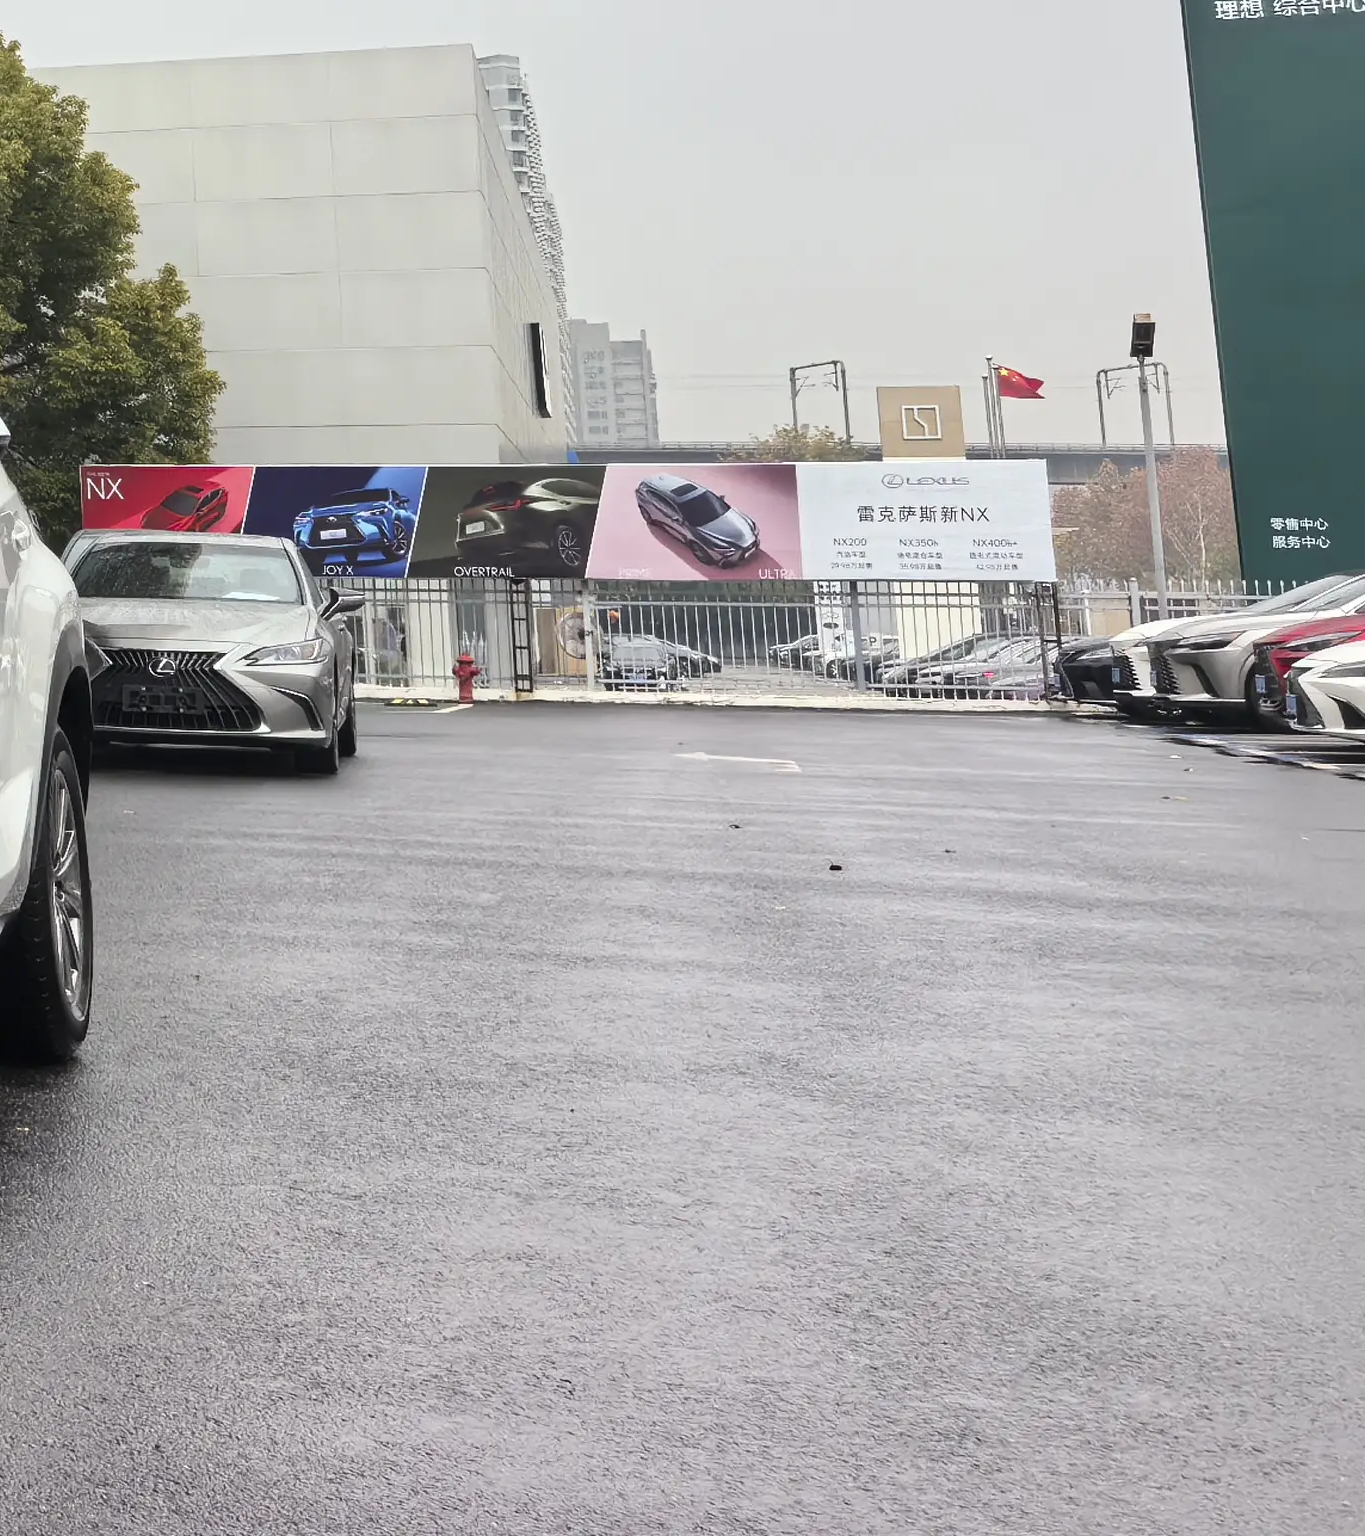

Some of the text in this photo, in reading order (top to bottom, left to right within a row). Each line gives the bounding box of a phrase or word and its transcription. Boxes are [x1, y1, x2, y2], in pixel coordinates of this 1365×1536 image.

[906, 476, 970, 486] LEXUS
[86, 477, 124, 500] NX
[857, 505, 990, 523] 雷克萨斯新NX
[1270, 517, 1329, 531] 零售中心
[833, 537, 867, 546] NX200
[899, 538, 939, 547] NX350h
[1272, 535, 1331, 549] 服务中心
[321, 565, 354, 576] JOY X
[454, 567, 515, 578] OVERTRAIL
[758, 568, 797, 580] ULTRA
